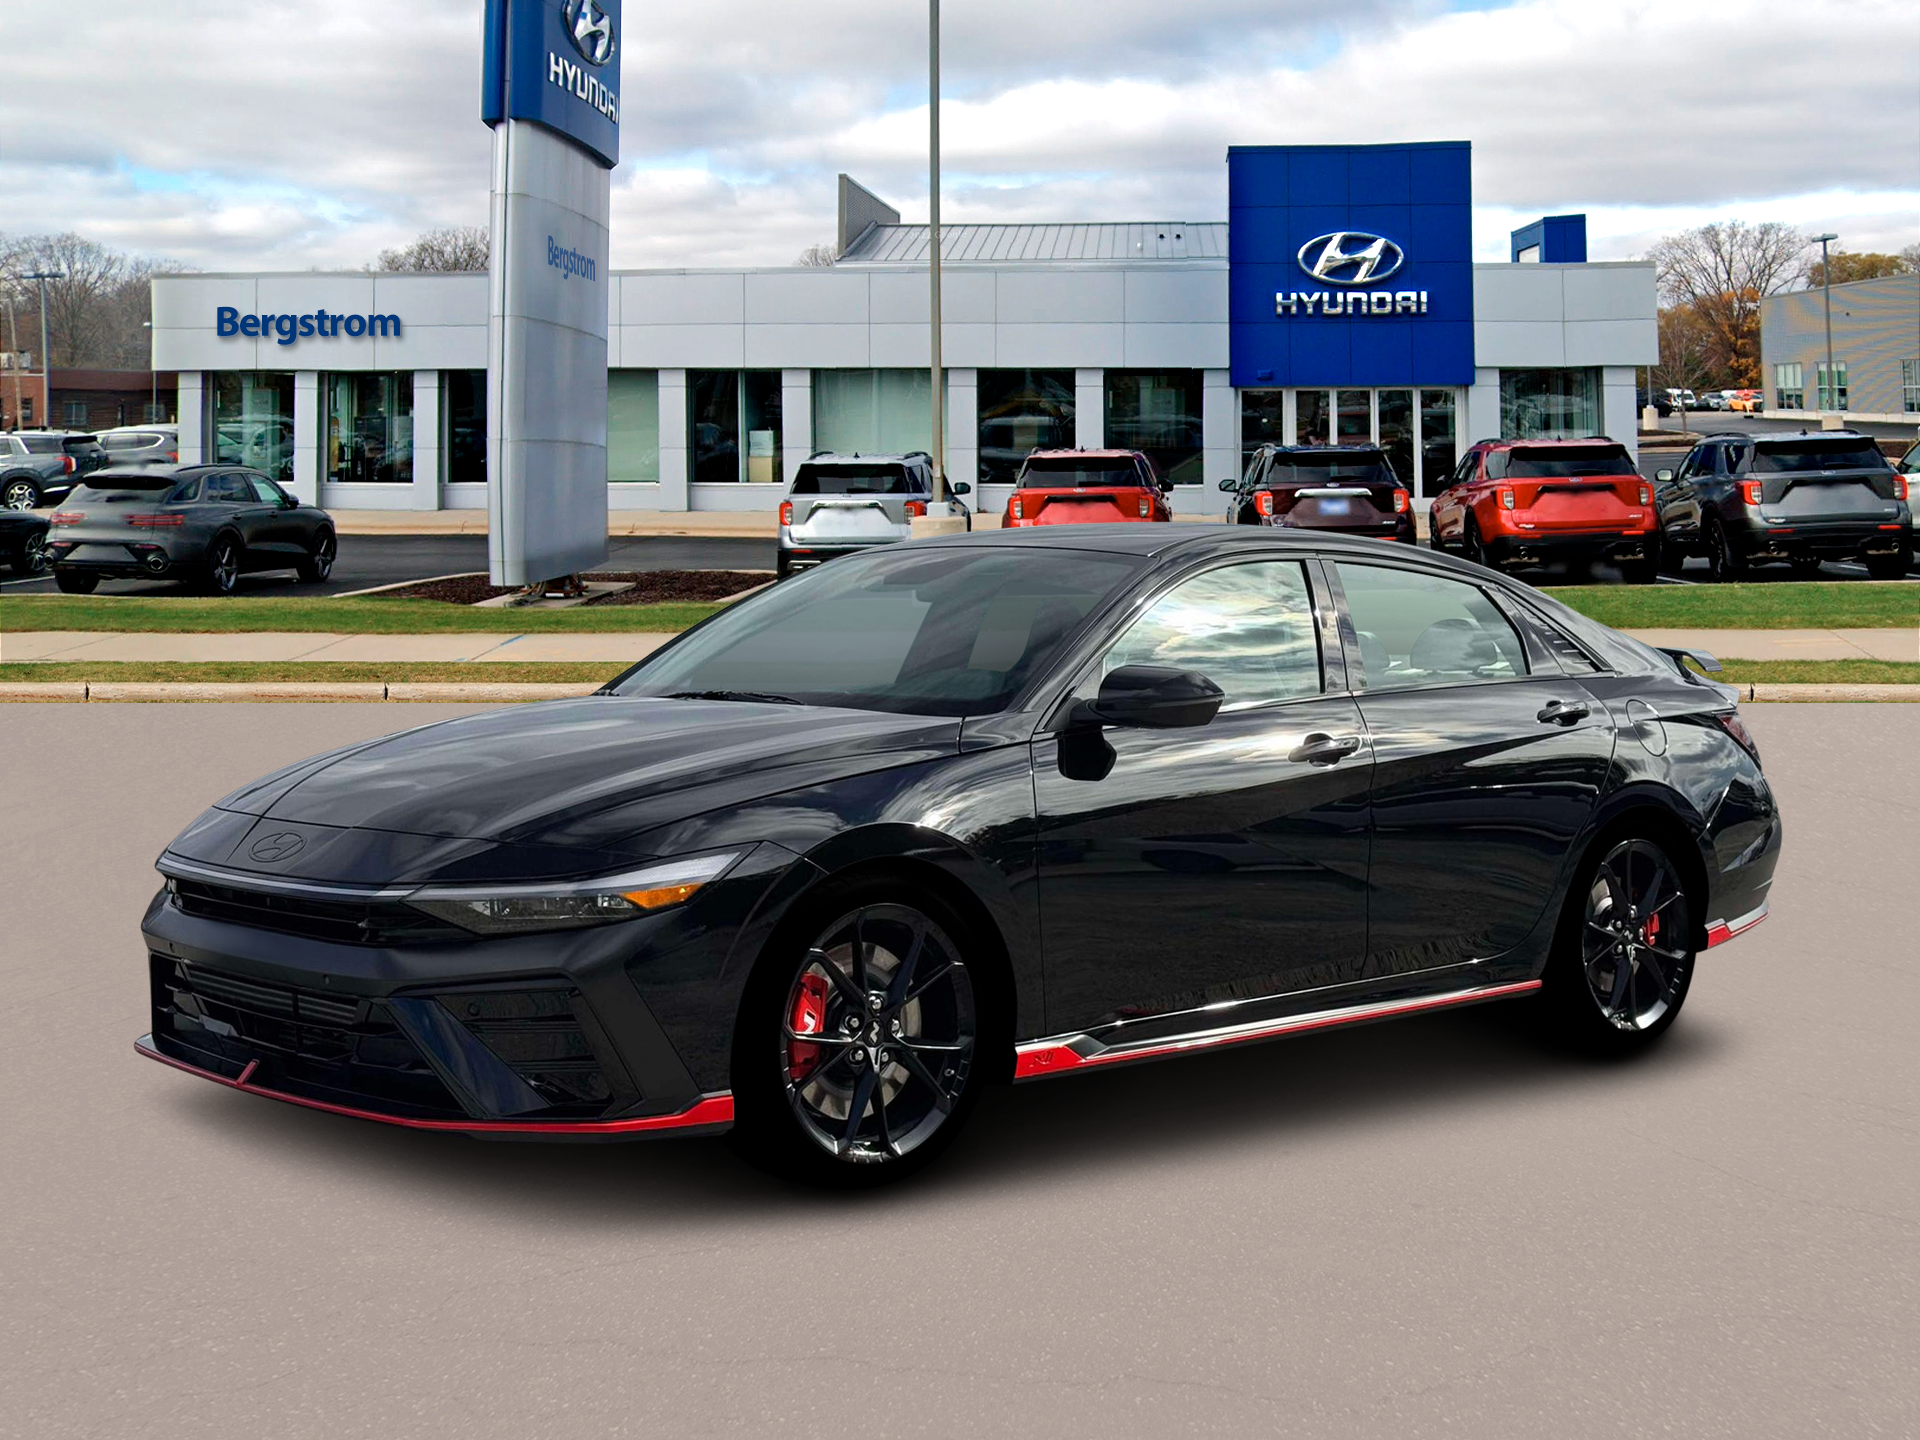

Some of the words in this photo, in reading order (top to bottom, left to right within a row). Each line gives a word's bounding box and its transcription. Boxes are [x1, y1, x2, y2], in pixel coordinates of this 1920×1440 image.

[548, 235, 595, 281] Bergstrom
[1275, 290, 1428, 315] HYUNDAI
[216, 306, 401, 346] Bergstrom
